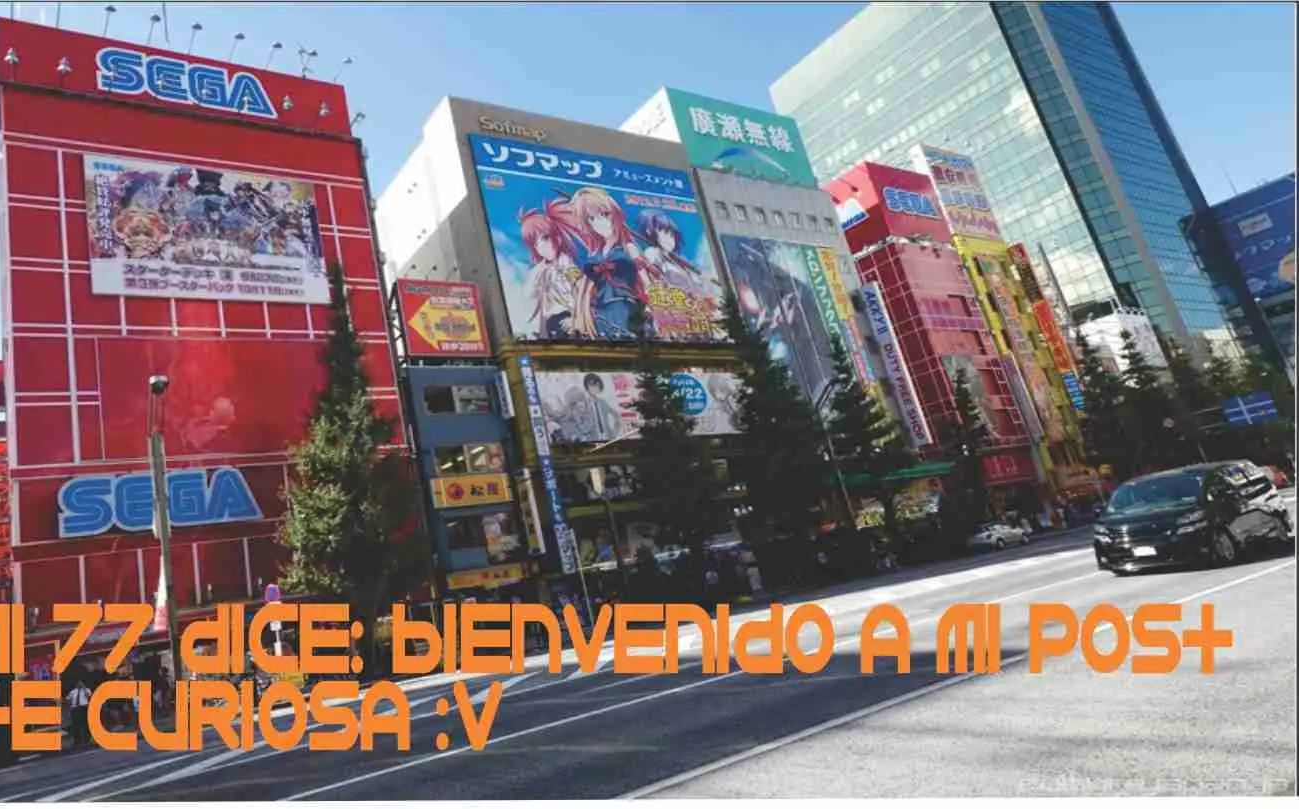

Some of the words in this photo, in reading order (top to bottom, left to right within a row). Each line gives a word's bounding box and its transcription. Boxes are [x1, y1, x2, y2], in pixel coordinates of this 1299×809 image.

[95, 47, 278, 119] SEGA
[479, 115, 548, 143] Sofmap
[482, 141, 603, 179] ソフマップ
[884, 343, 901, 374] DUTY
[906, 408, 926, 440] SHOP
[58, 465, 265, 538] SEGA
